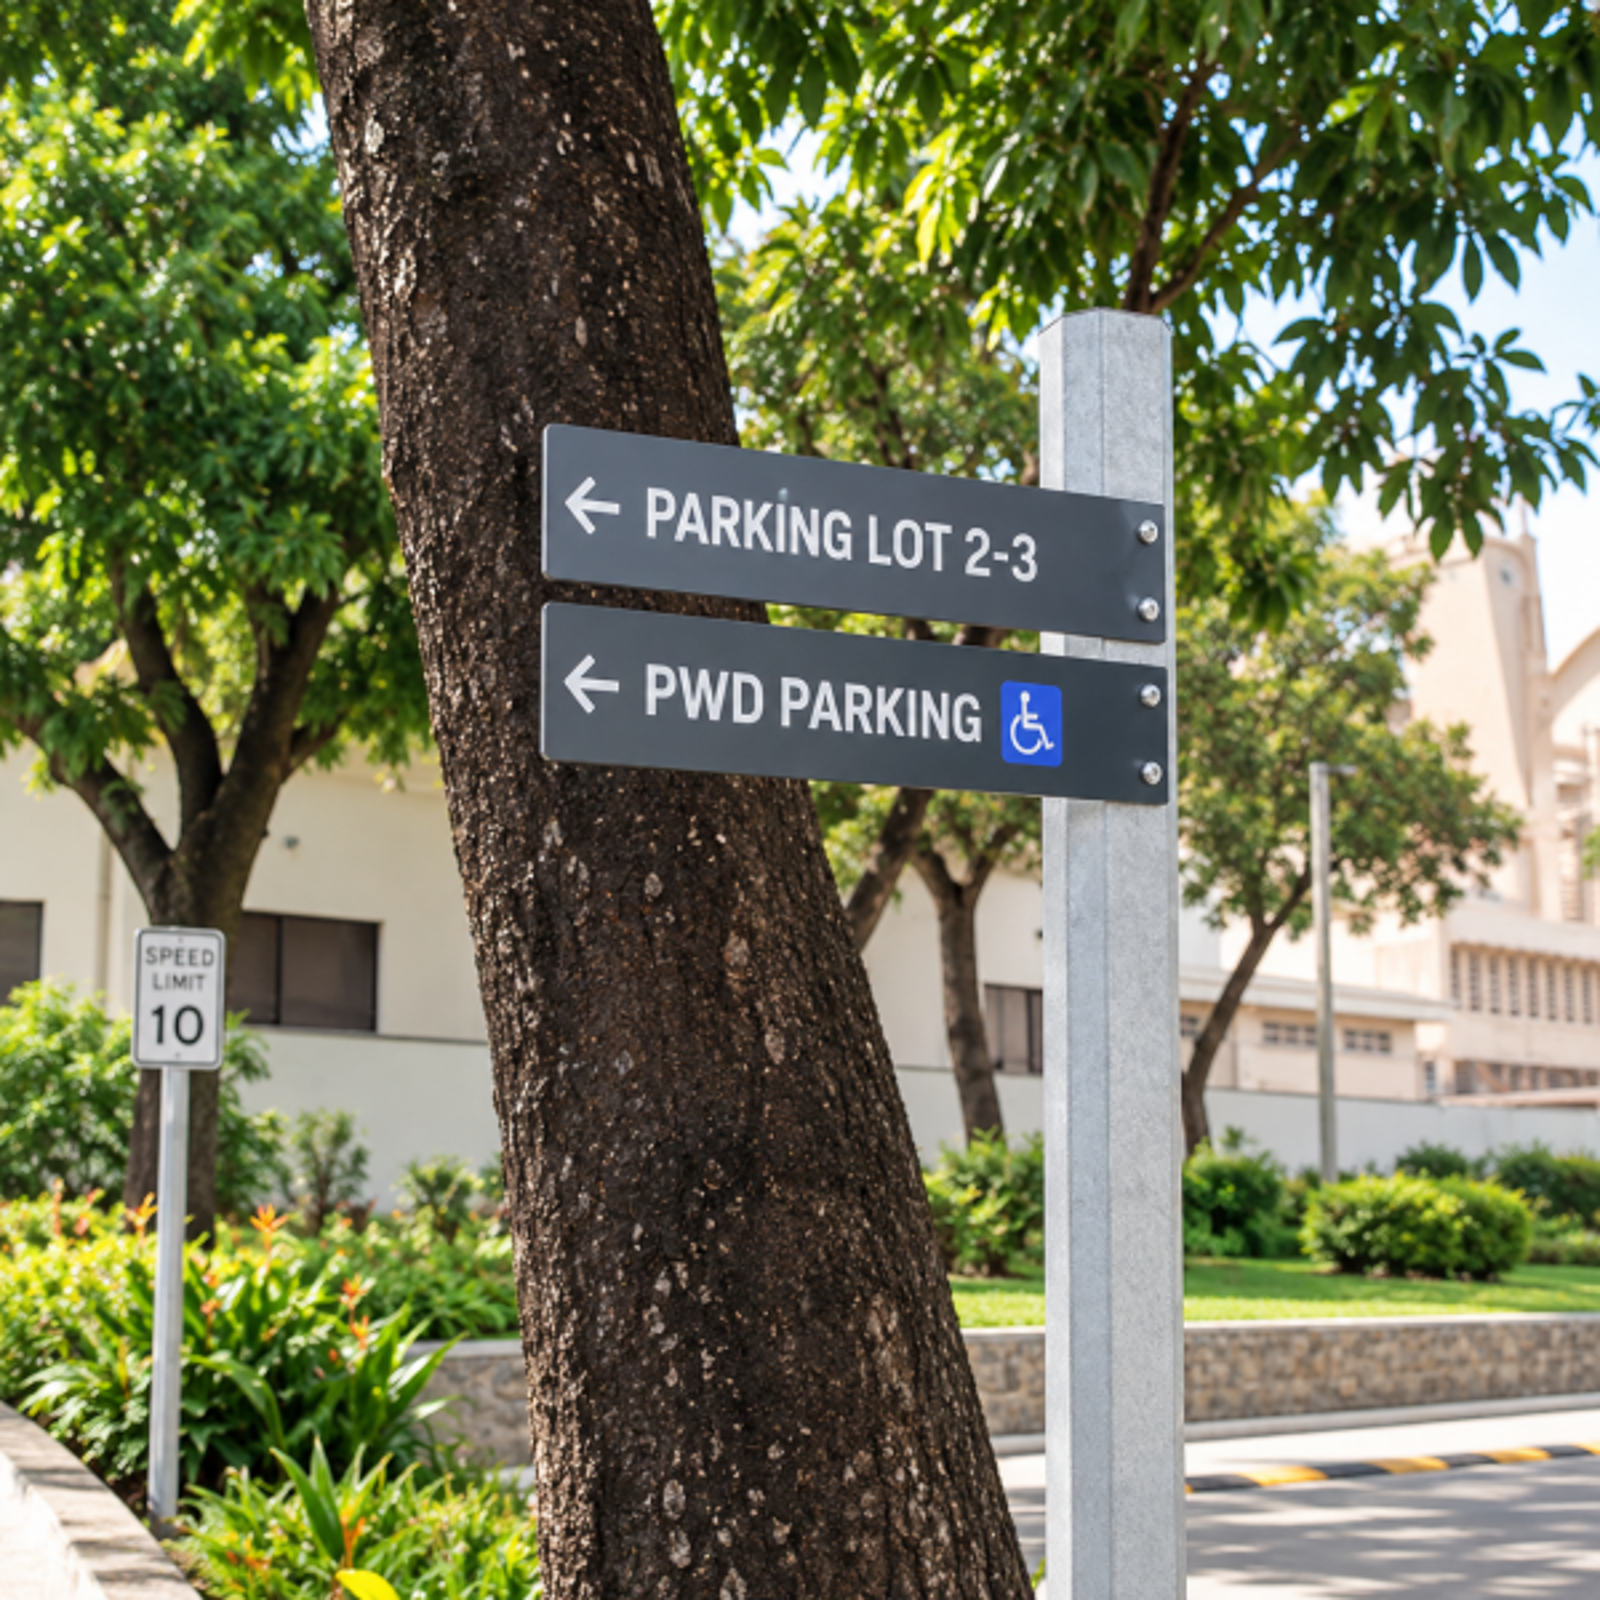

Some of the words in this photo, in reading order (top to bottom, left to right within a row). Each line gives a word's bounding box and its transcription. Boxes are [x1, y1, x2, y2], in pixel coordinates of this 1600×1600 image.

[645, 486, 853, 562] PARKING
[867, 514, 953, 572] LOT
[965, 527, 1039, 583] 2-3
[645, 663, 764, 724] PWD
[779, 676, 982, 743] PARKING
[146, 946, 215, 967] SPEED
[152, 972, 205, 991] LIMIT
[151, 1003, 204, 1046] 10
